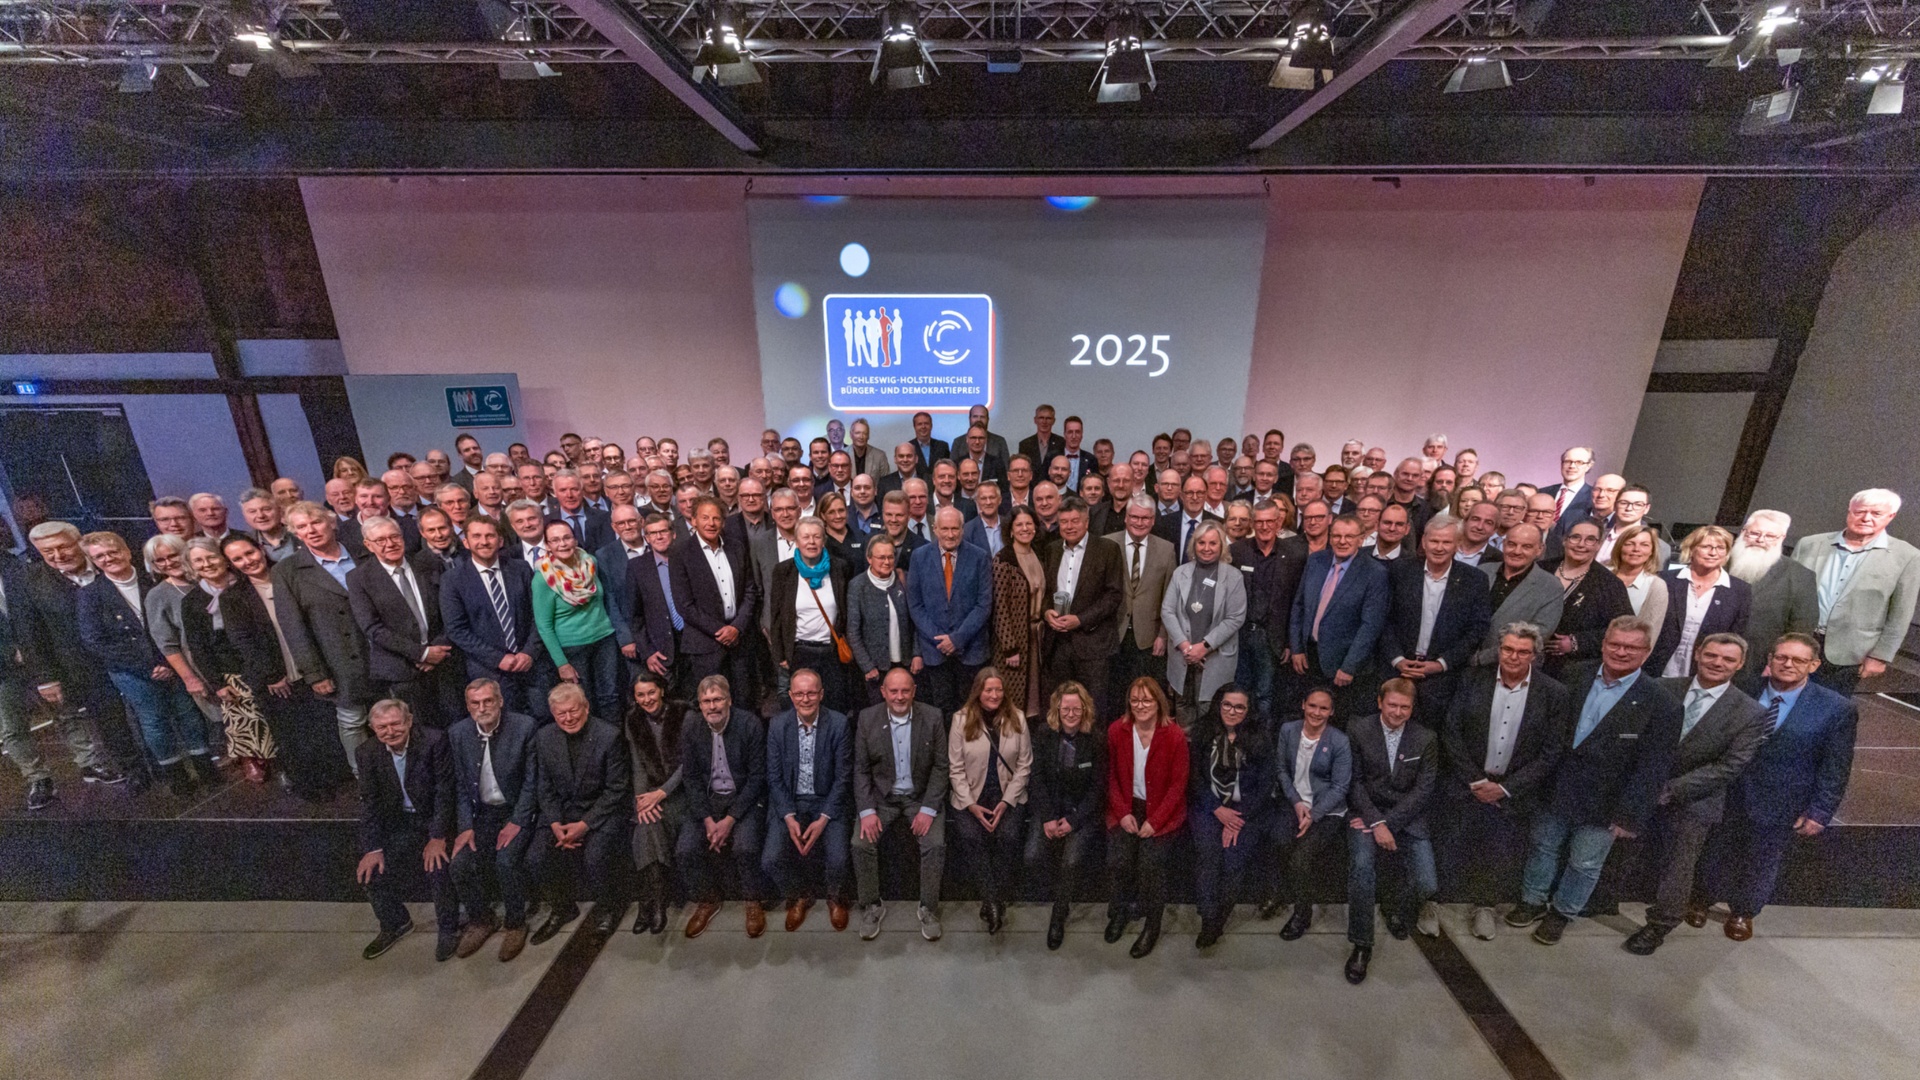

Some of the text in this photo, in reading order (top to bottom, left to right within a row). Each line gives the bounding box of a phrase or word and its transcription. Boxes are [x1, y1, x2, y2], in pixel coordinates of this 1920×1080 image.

[1069, 333, 1171, 378] 2025
[846, 375, 974, 385] SCHLESWIG-HOLSTEINISCHER
[840, 385, 981, 395] BÜRGER- UND DEMOKRATIEPREIS
